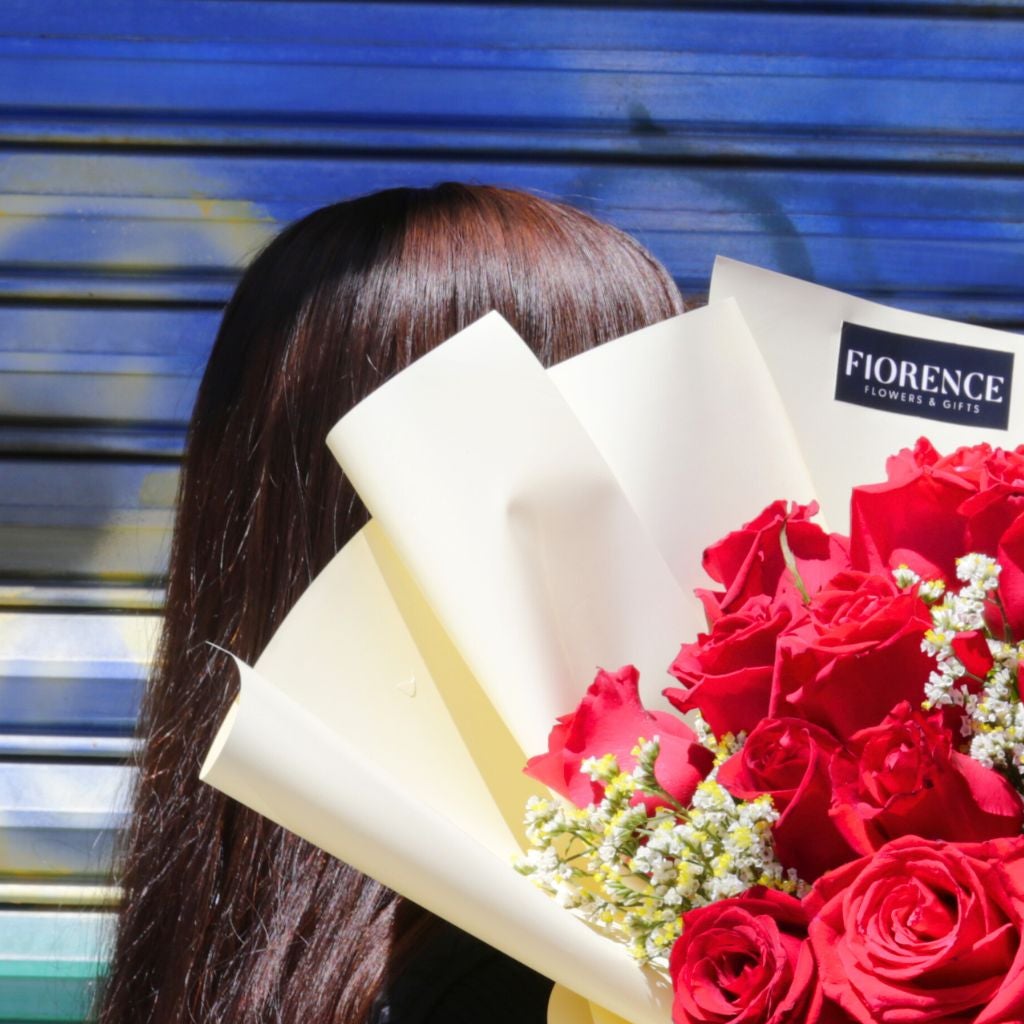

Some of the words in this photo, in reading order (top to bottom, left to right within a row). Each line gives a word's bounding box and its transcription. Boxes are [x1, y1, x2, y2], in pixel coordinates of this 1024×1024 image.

[845, 349, 1005, 403] FIORENCE
[864, 385, 923, 405] FLOWERS
[928, 397, 936, 407] &
[942, 400, 981, 414] GIFTS
